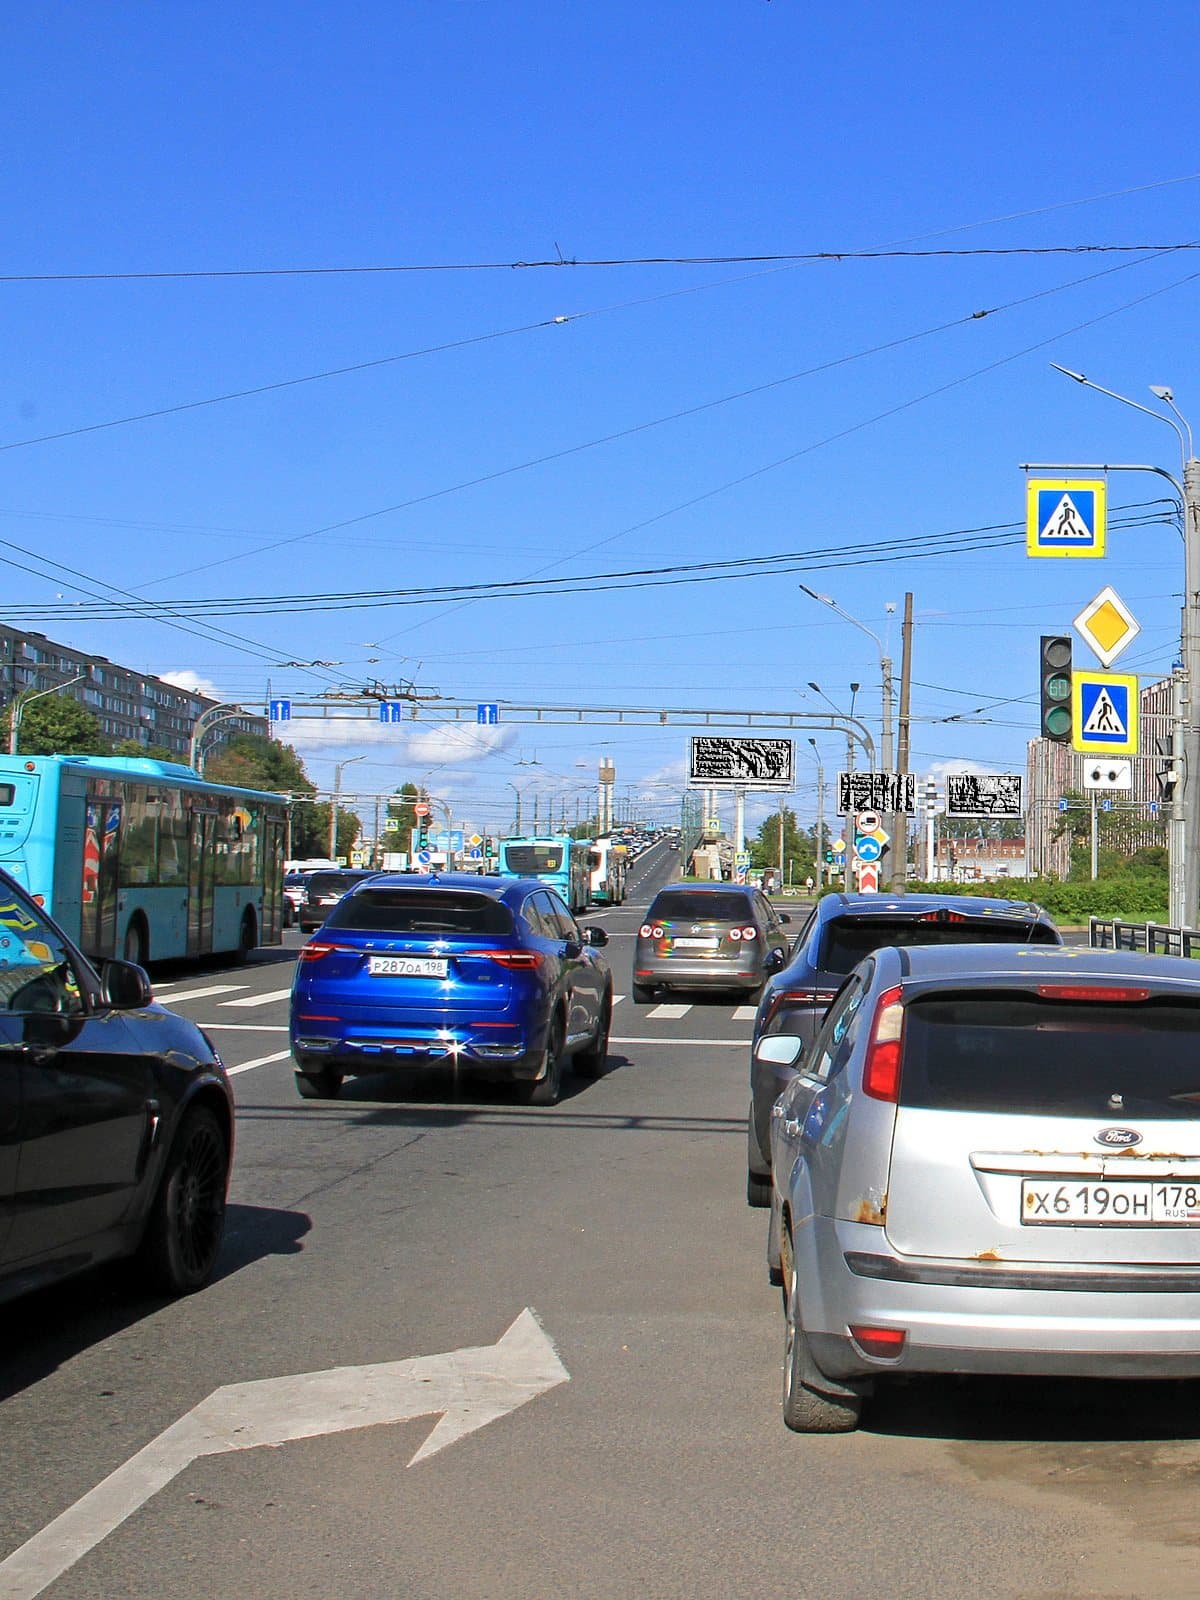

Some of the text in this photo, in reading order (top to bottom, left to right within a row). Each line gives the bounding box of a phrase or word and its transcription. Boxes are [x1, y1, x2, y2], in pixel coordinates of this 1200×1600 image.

[1105, 1130, 1133, 1143] Ford
[1034, 1186, 1197, 1216] Х619ОН 178
[1165, 1209, 1186, 1218] RUS
